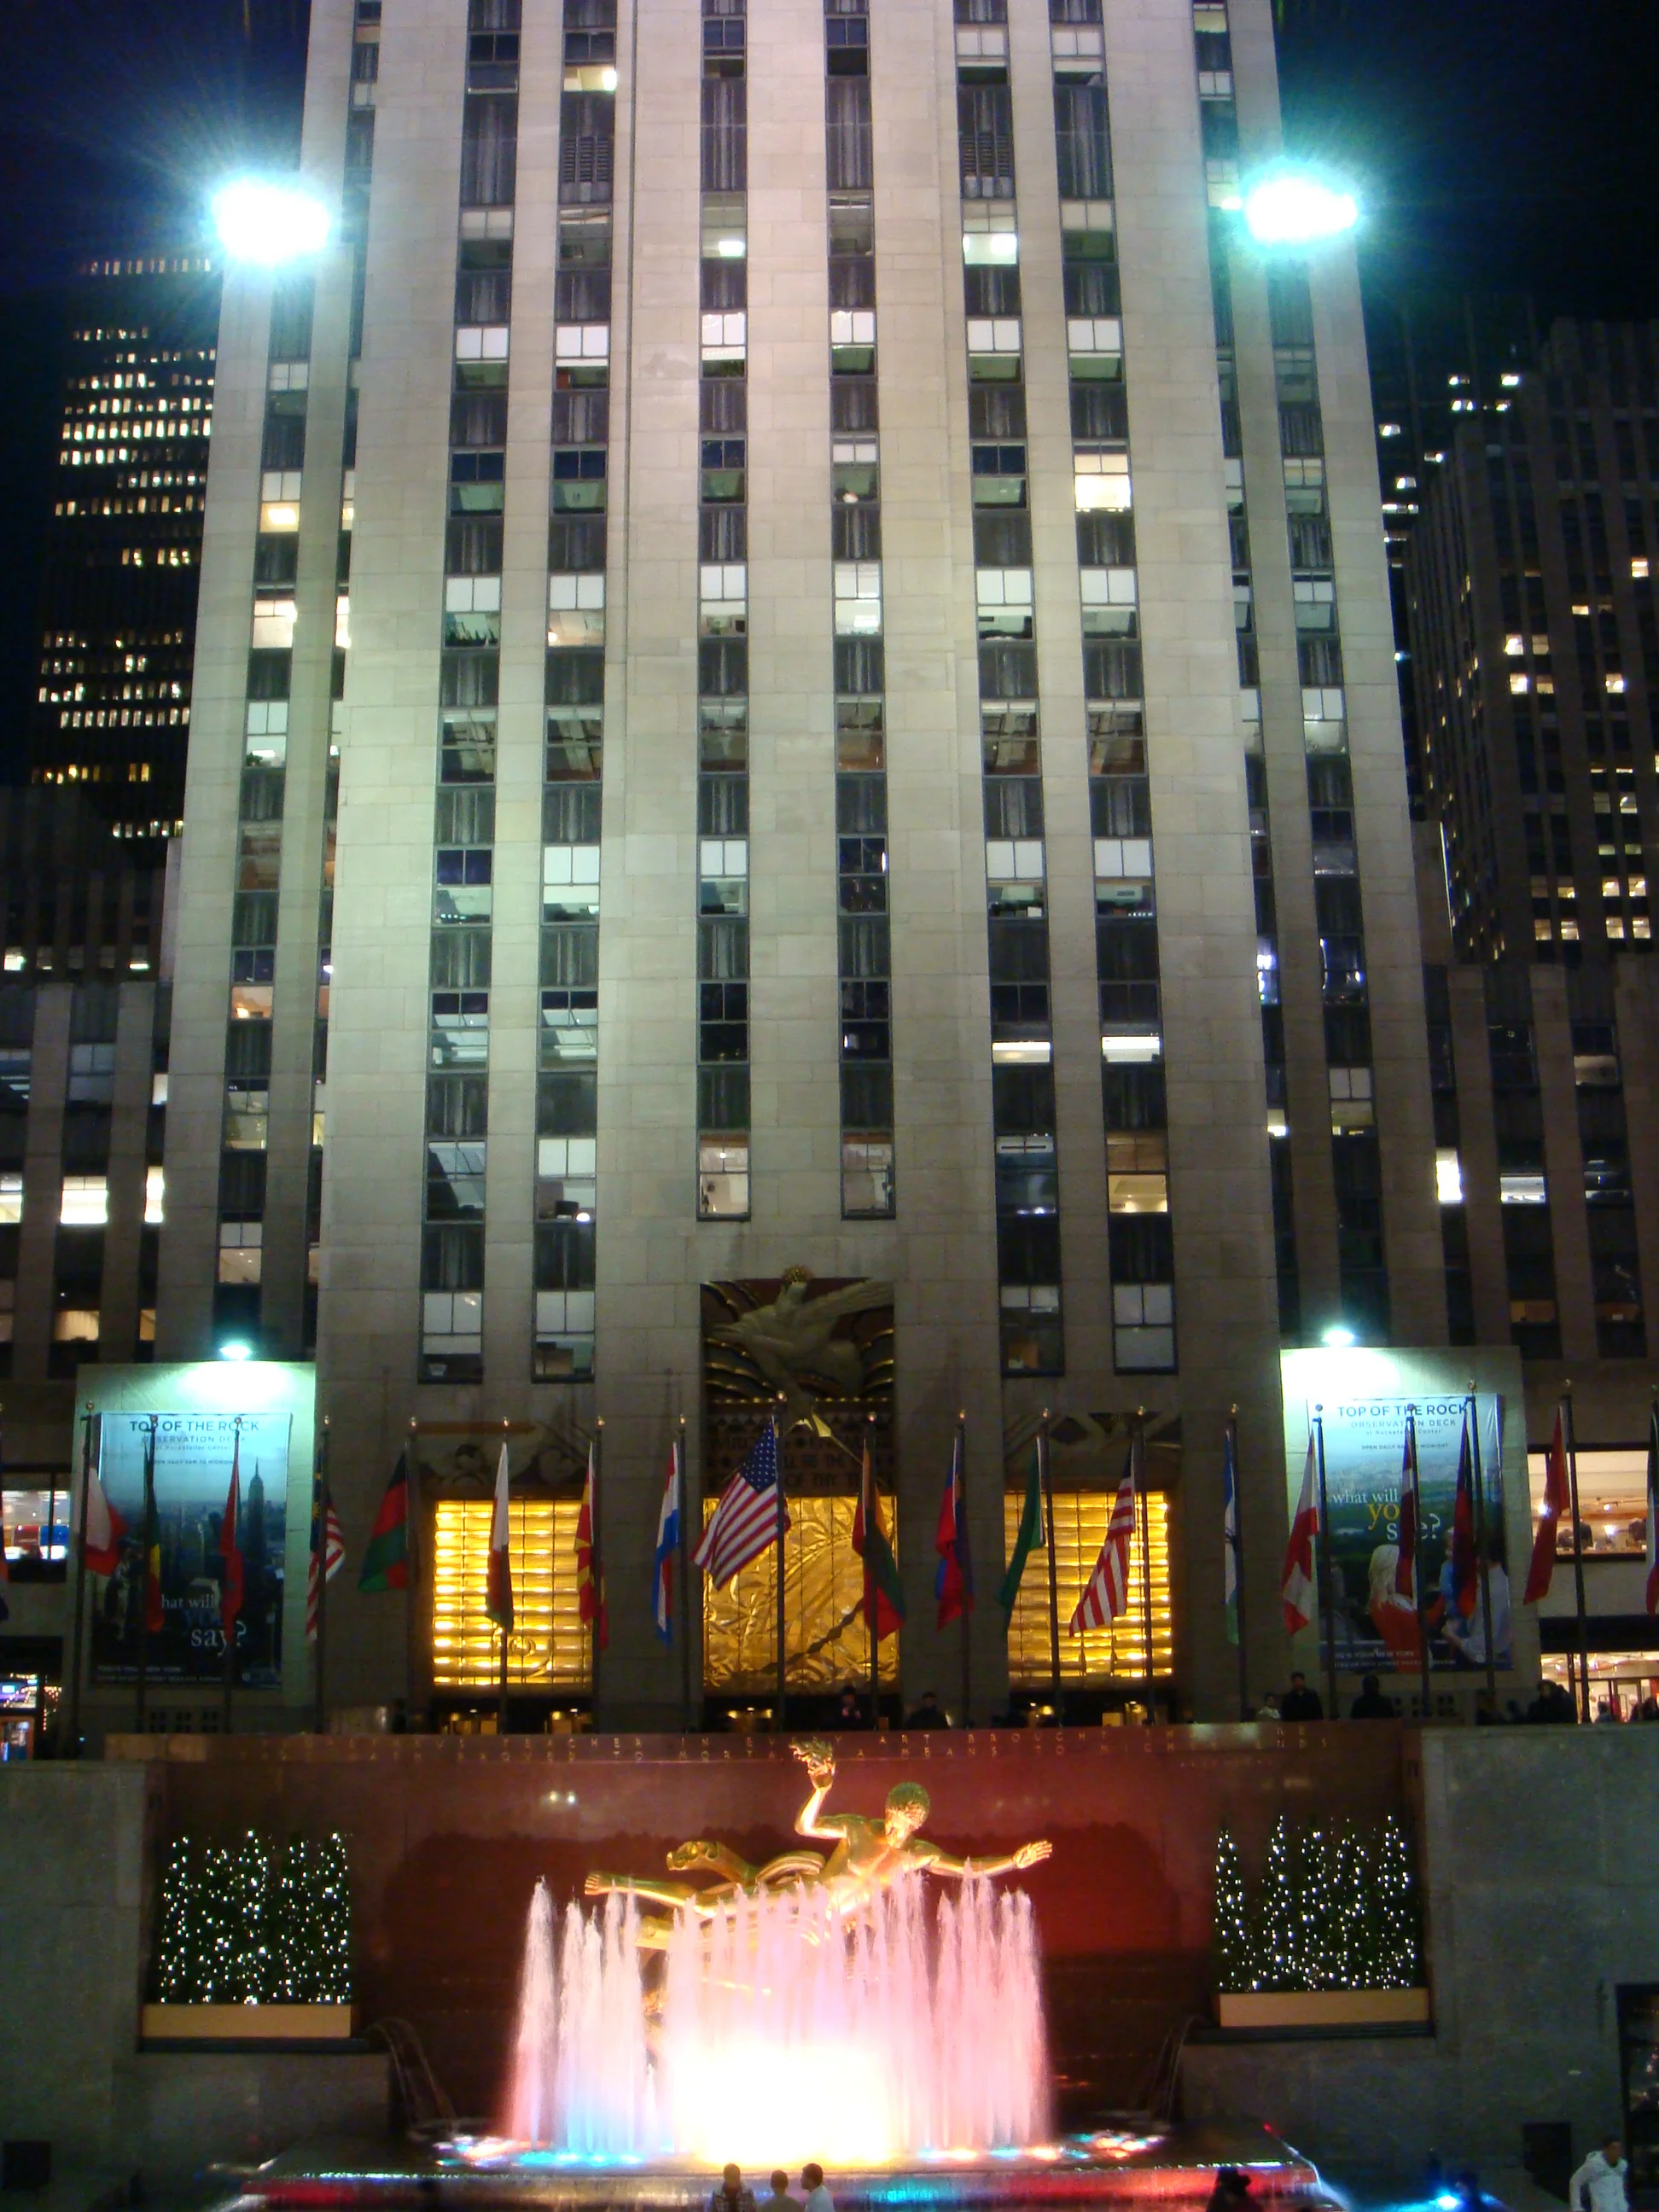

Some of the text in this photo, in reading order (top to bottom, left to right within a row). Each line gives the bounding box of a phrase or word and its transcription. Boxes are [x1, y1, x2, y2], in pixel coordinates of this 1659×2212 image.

[1337, 1406, 1366, 1417] TOP
[1371, 1406, 1390, 1417] OF
[1426, 1403, 1466, 1416] ROCK
[162, 1420, 182, 1432] OF
[186, 1420, 214, 1432] THE
[218, 1420, 259, 1432] ROCK
[1351, 1418, 1457, 1429] OBSERVATN DECK
[142, 1435, 215, 1444] OSERVATION
[1331, 1487, 1398, 1504] what will
[1366, 1503, 1400, 1531] yo
[1386, 1512, 1441, 1541] se?
[160, 1593, 214, 1609] hat will
[680, 1736, 707, 1747] IN
[878, 1733, 930, 1744] ART
[613, 1749, 643, 1761] TO
[900, 1745, 997, 1758] MEANS
